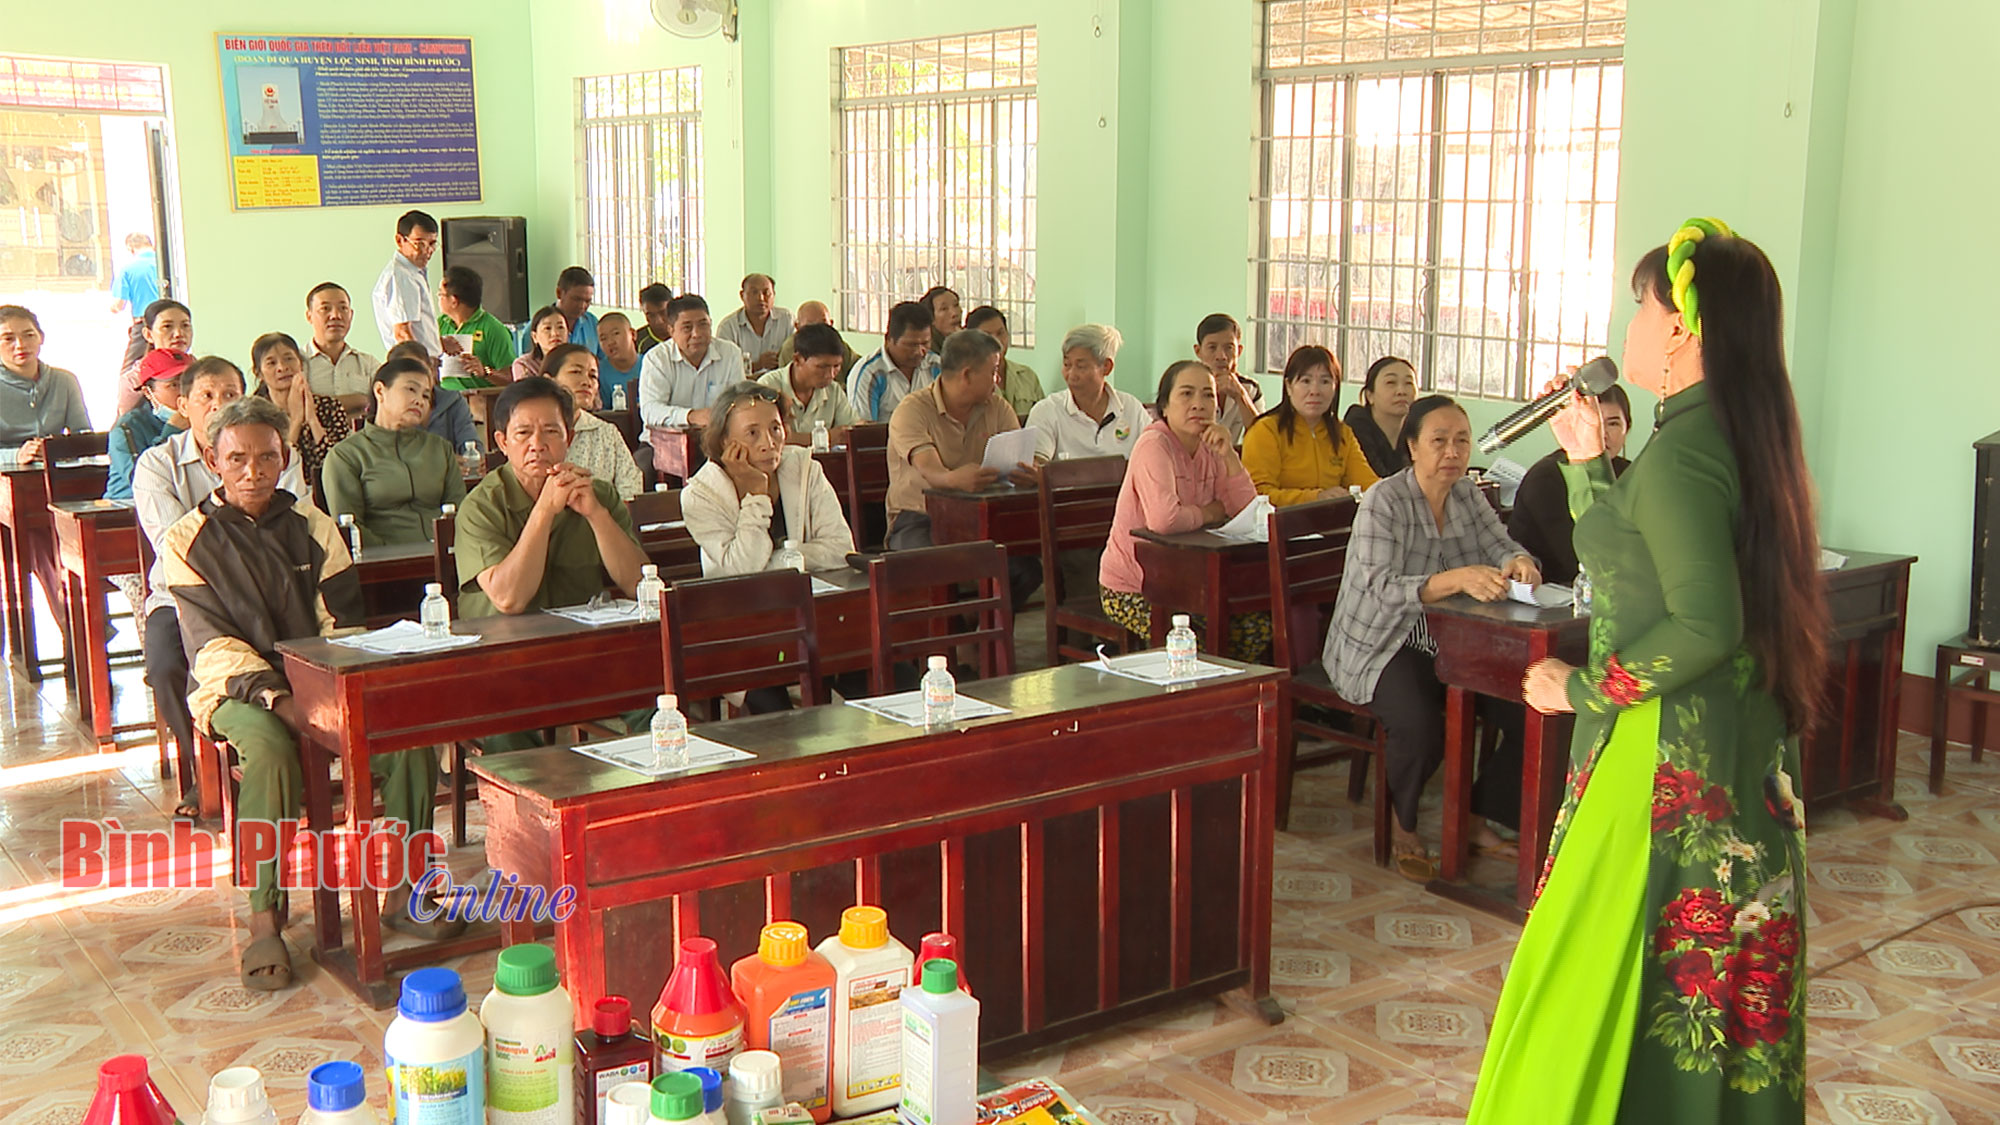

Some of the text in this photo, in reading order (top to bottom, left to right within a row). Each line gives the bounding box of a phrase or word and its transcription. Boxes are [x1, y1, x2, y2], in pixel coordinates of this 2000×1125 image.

[269, 37, 292, 52] QUỐC
[295, 40, 310, 52] GIA
[278, 57, 300, 65] QUA
[301, 57, 332, 66] HUYỆN
[334, 56, 353, 66] LỘC
